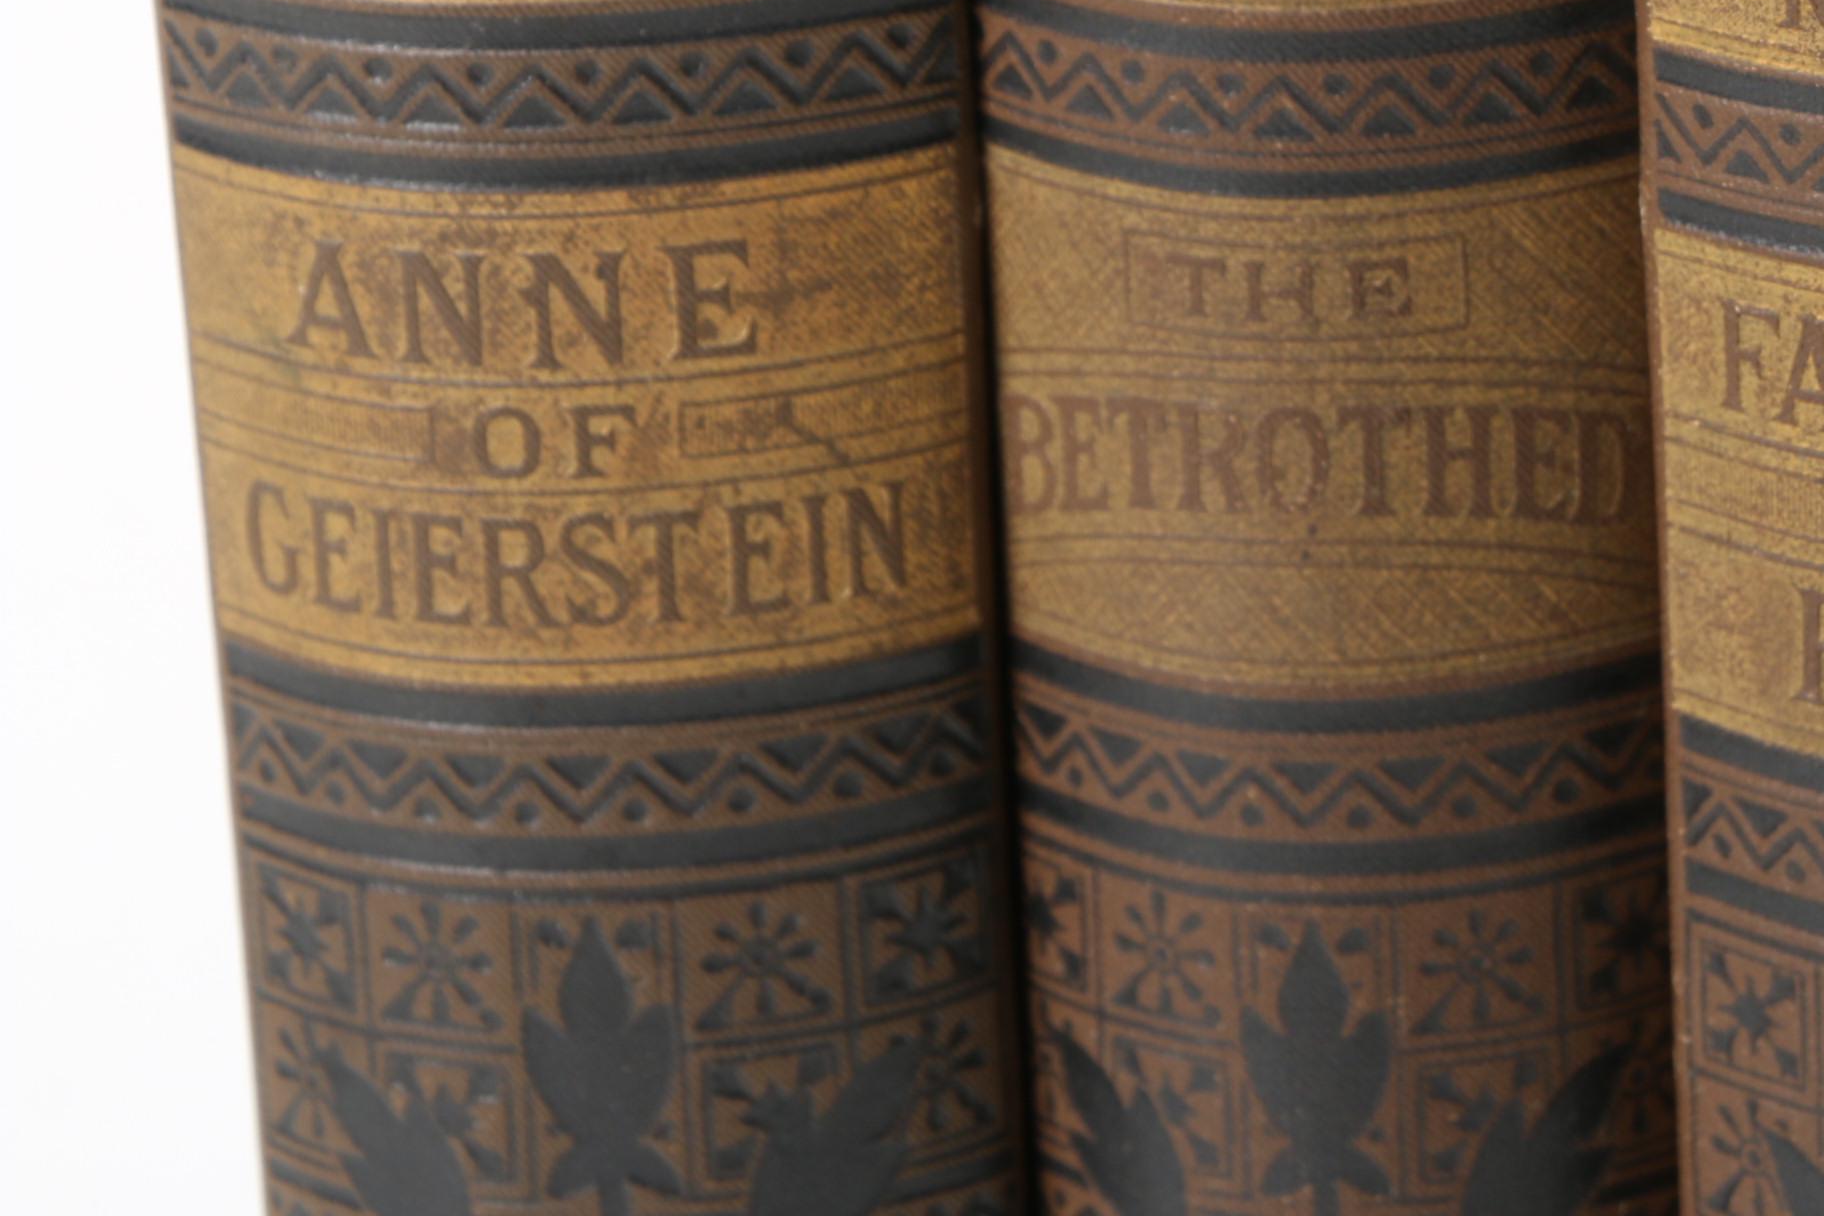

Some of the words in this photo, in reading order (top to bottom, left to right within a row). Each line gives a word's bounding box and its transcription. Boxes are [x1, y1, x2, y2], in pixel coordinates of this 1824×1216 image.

[286, 239, 761, 372] ANNE
[1165, 252, 1413, 324] THE
[470, 403, 638, 480] OF
[1004, 392, 1648, 520] BETROTHED
[245, 481, 910, 629] GEIERSTEIN
